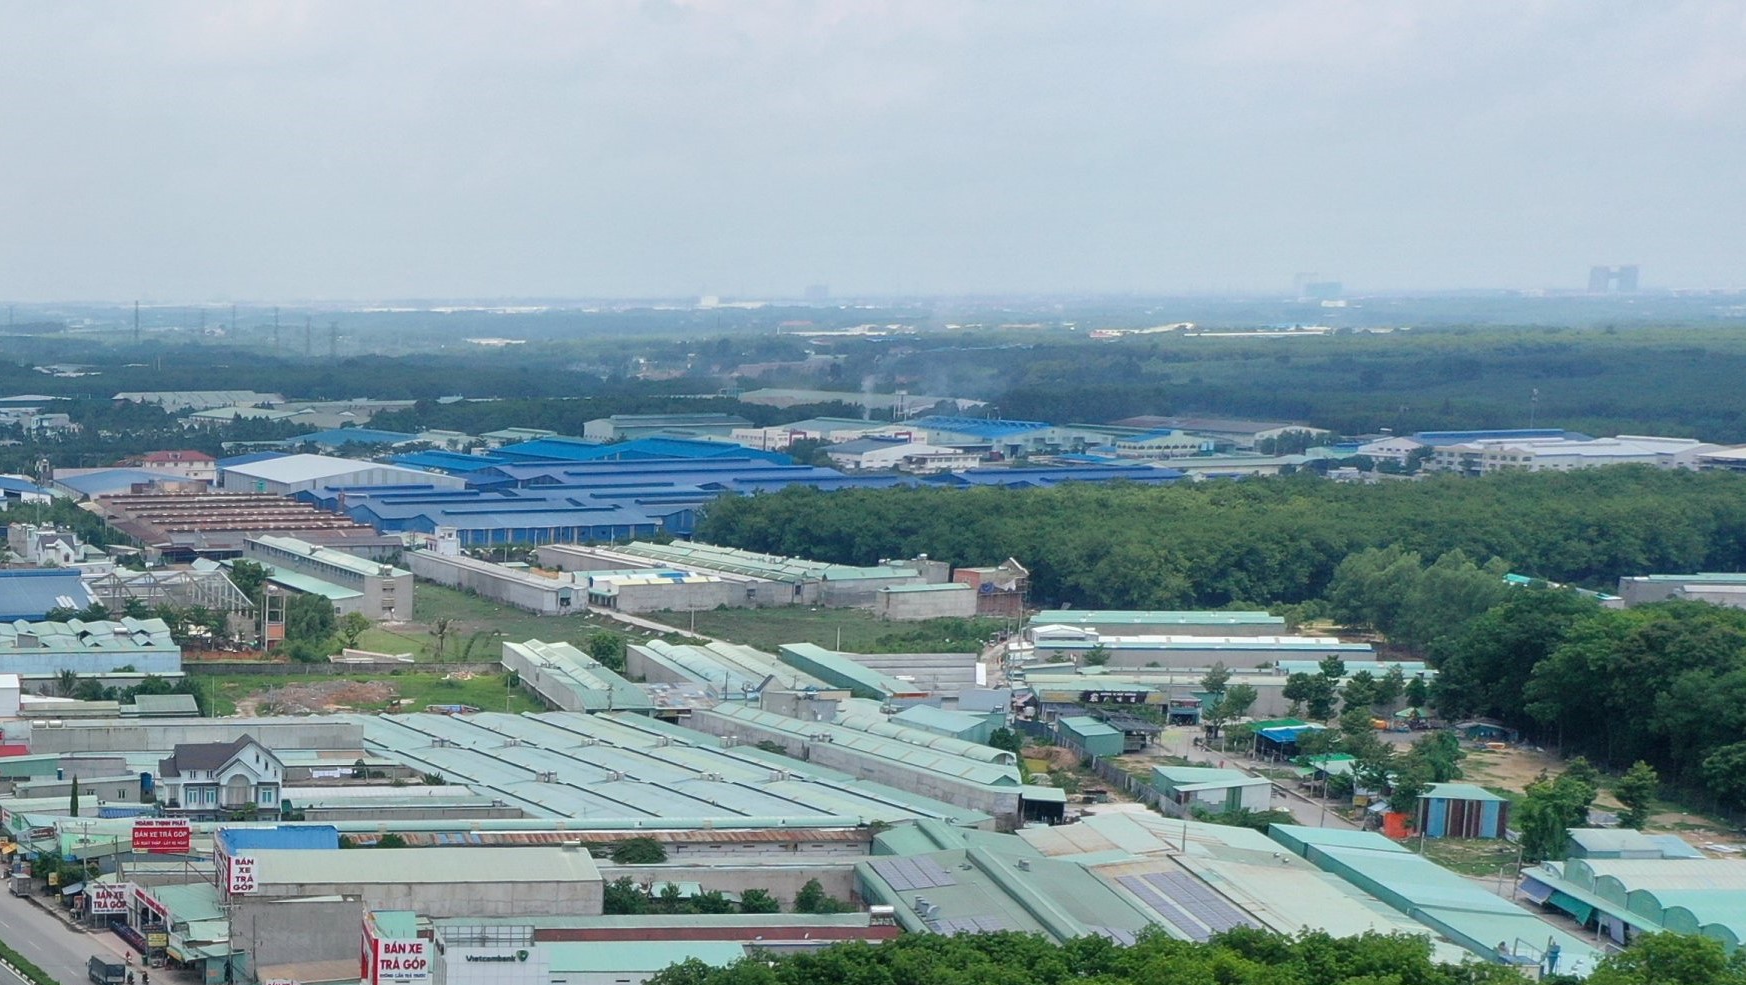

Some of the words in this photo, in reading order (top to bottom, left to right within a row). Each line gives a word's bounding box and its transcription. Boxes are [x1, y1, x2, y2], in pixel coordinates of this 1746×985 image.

[134, 829, 148, 838] BÁN
[173, 829, 188, 838] GÓP
[235, 857, 254, 866] BÁN
[233, 882, 254, 891] GÓP
[95, 889, 112, 900] BÁN
[114, 891, 124, 900] XE
[110, 899, 127, 909] GÓP
[384, 941, 406, 954] BÁN
[408, 943, 423, 954] XE
[466, 954, 516, 962] Vietcombank
[380, 957, 400, 970] TRẢ
[403, 956, 427, 970] GÓP
